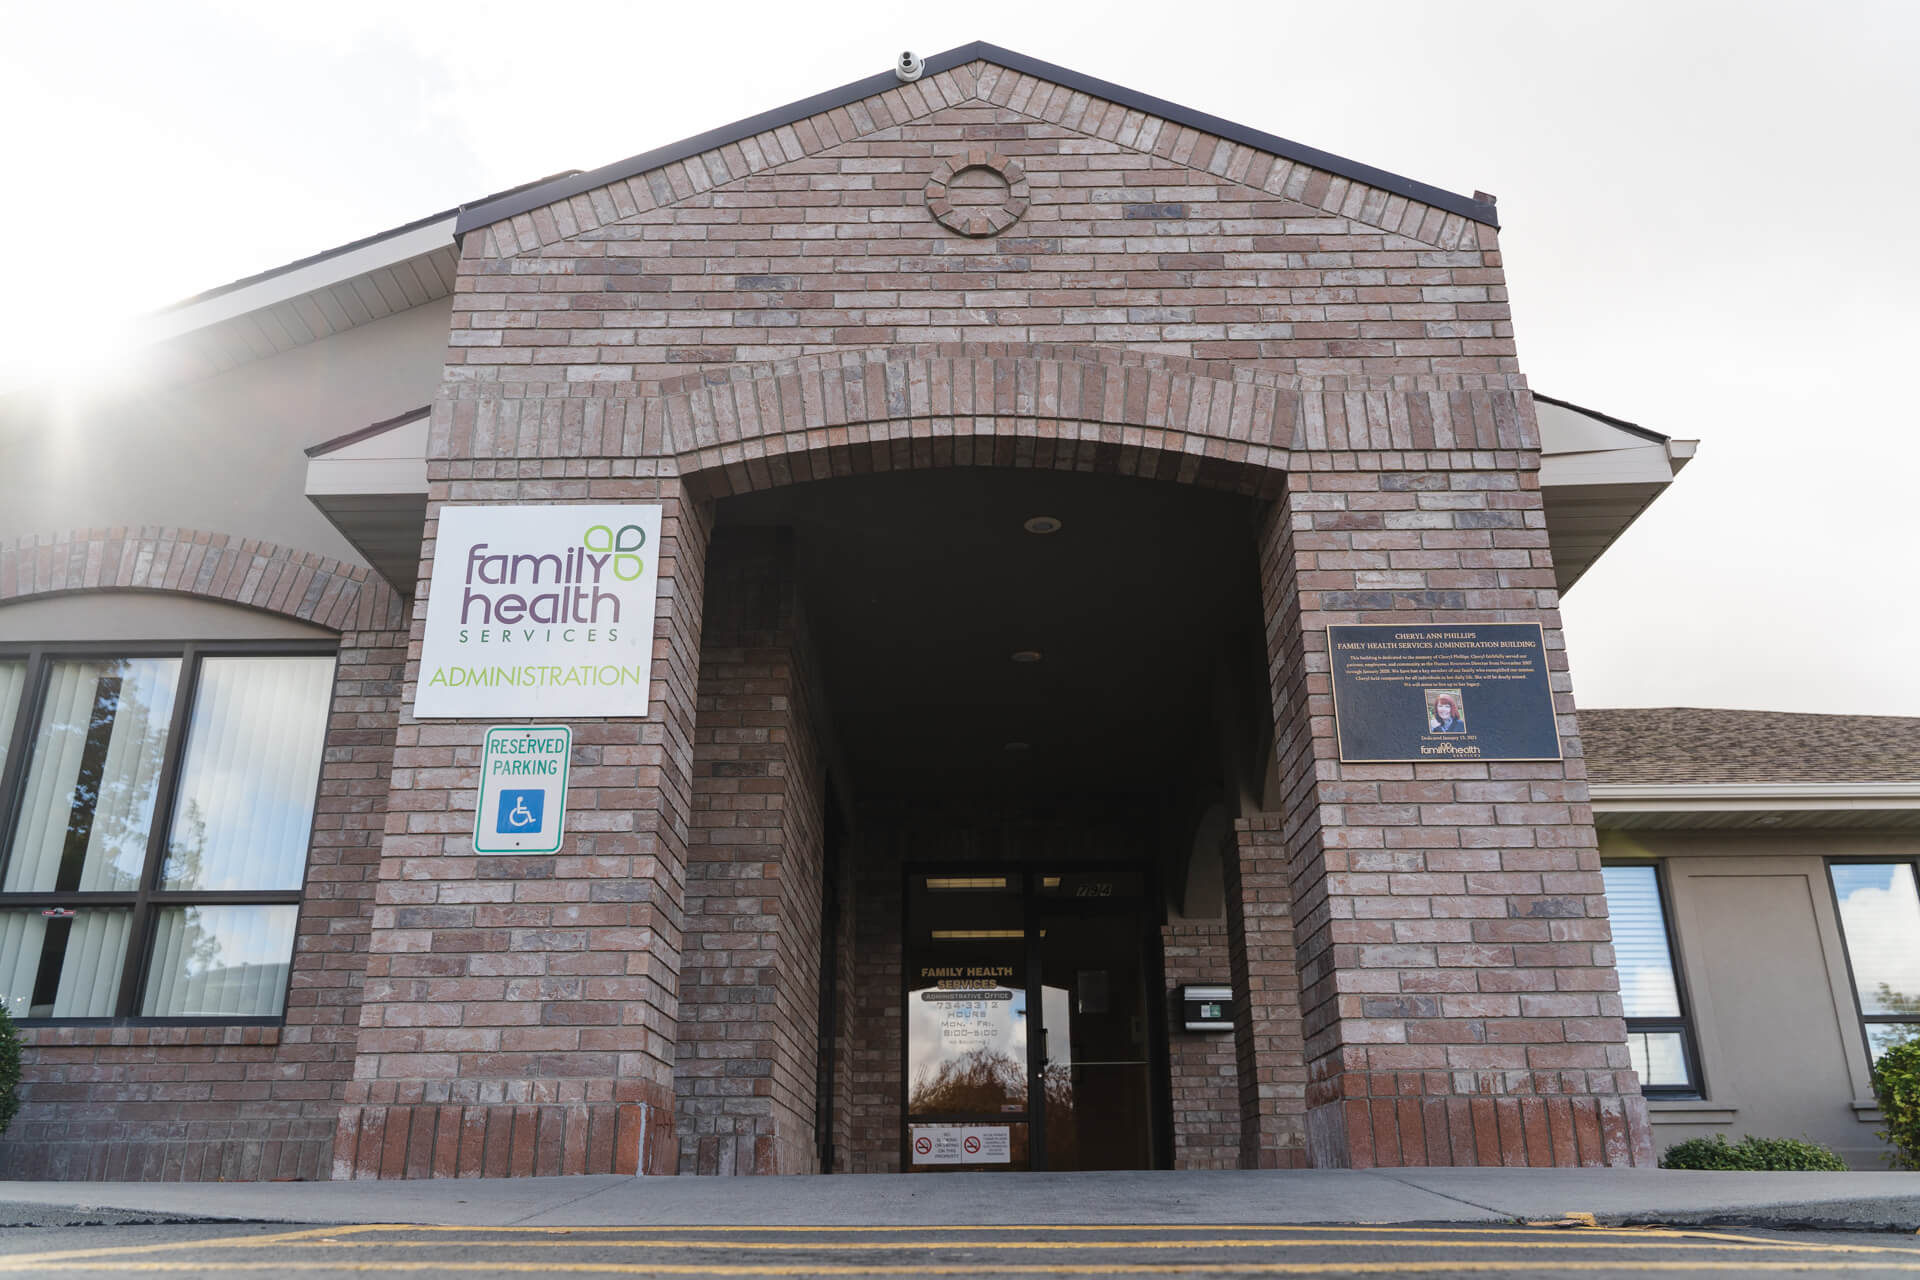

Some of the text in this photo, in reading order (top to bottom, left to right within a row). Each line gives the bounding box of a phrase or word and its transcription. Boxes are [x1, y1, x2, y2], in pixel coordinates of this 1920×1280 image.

[465, 543, 612, 585] family
[460, 586, 621, 625] health
[459, 628, 619, 643] SERVICES
[1434, 641, 1499, 649] ADMINISTRATION
[428, 664, 641, 688] ADMINISTRATION
[490, 738, 565, 755] RESERVED
[493, 760, 558, 776] PARKING
[921, 967, 1013, 977] FAMILY HEALTH
[937, 979, 997, 989] SERVICES
[925, 992, 982, 1000] ADMINISTRATIVE
